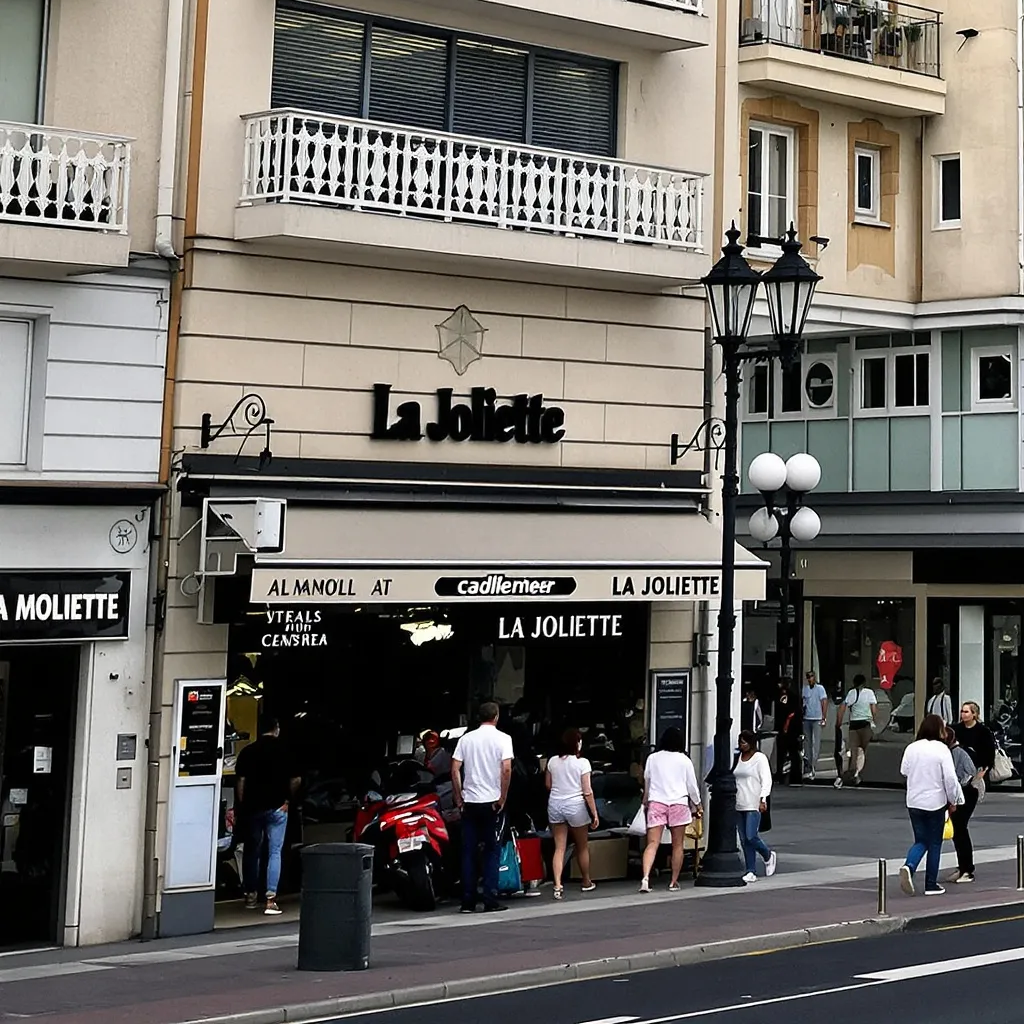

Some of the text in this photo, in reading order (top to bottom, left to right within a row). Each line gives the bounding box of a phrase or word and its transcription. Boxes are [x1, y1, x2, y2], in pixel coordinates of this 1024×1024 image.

[370, 383, 566, 443] La Joliette
[371, 579, 393, 596] AT
[612, 576, 719, 596] LA JOLIETTE
[15, 593, 119, 621] MOLIETTE
[498, 614, 623, 639] LA JOLIETTE
